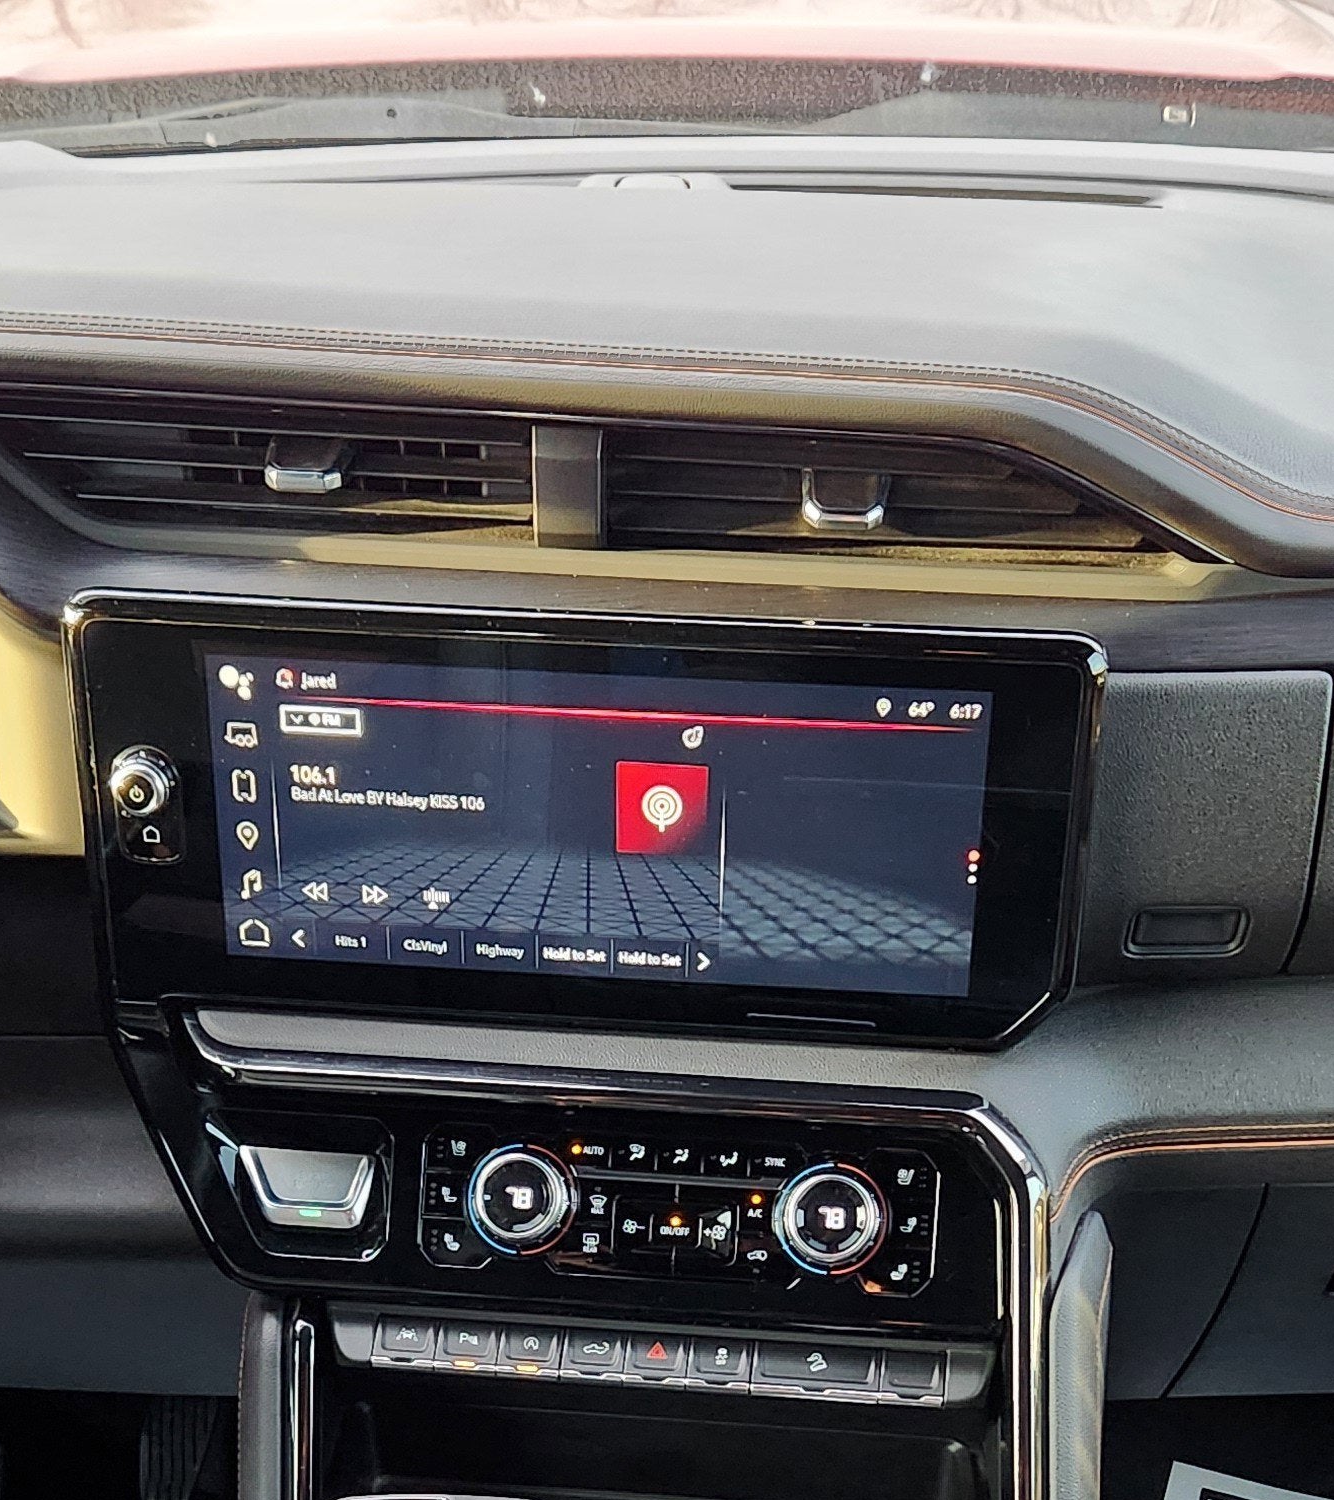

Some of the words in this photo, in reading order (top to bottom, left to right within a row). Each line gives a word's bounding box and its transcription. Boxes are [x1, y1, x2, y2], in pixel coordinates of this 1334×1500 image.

[301, 671, 337, 690] Jared
[949, 703, 983, 719] 6:17
[322, 713, 341, 727] FM
[289, 764, 336, 785] 106.1
[291, 785, 317, 802] Bad
[318, 787, 335, 801] At
[334, 788, 366, 804] Love
[366, 790, 385, 805] BY
[385, 791, 429, 811] Halsey
[429, 794, 460, 810] KISS
[459, 796, 486, 811] 106
[335, 935, 361, 948] Hits
[476, 943, 525, 960] Highway
[542, 946, 571, 961] Hold
[571, 948, 587, 962] to
[586, 949, 608, 963] Set
[617, 951, 647, 966] Hold
[647, 953, 662, 966] to
[661, 953, 683, 967] Set
[582, 1145, 605, 1156] AUTO
[764, 1157, 787, 1168] SYNC
[747, 1208, 763, 1219] A/C
[659, 1225, 690, 1237] ON/OFF
